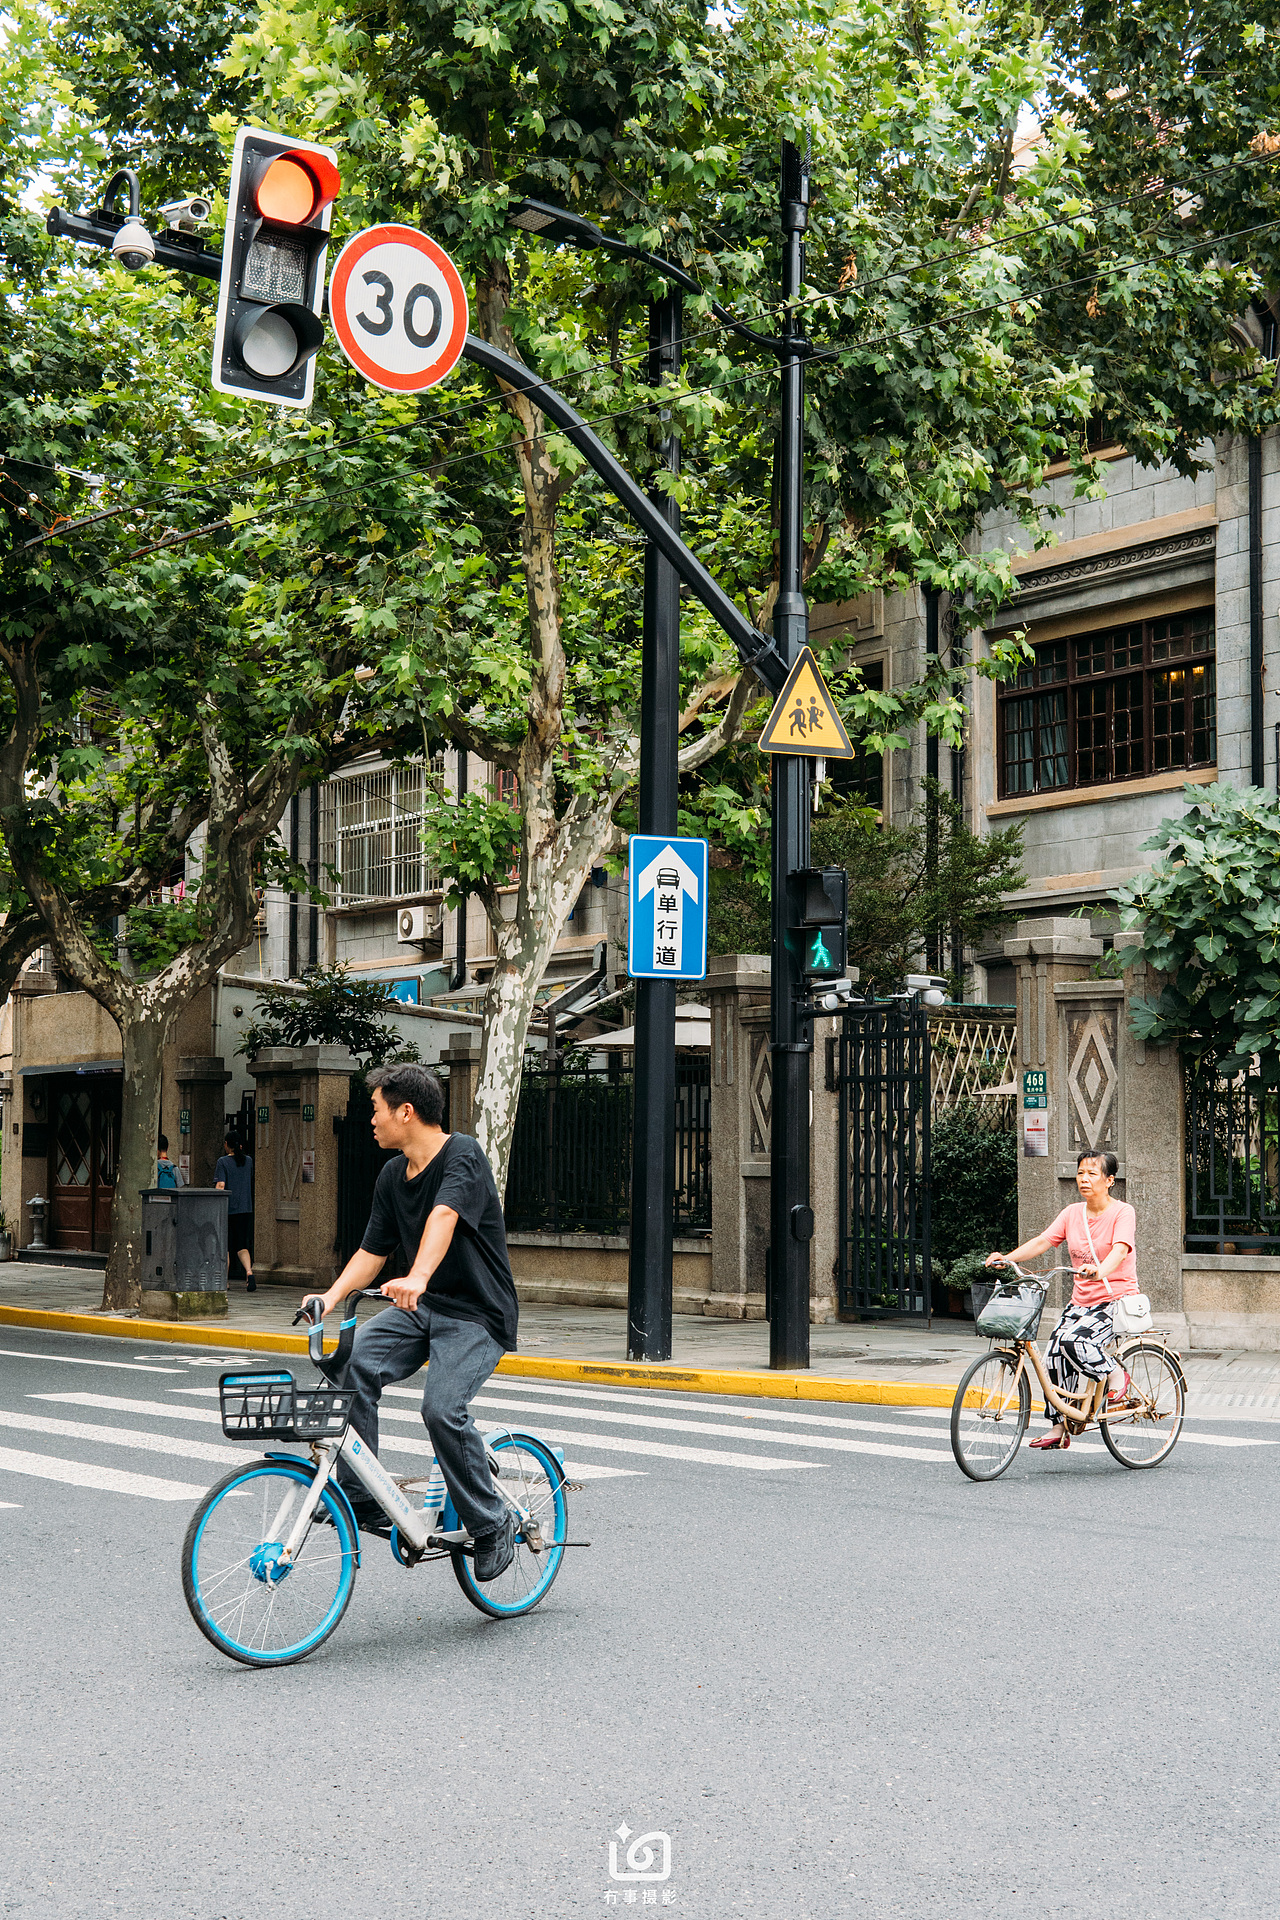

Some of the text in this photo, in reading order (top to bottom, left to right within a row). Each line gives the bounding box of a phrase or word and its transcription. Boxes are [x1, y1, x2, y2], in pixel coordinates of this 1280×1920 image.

[355, 269, 443, 349] 30
[655, 893, 679, 966] 单行道
[1026, 1073, 1044, 1087] 468
[259, 1108, 268, 1117] 472
